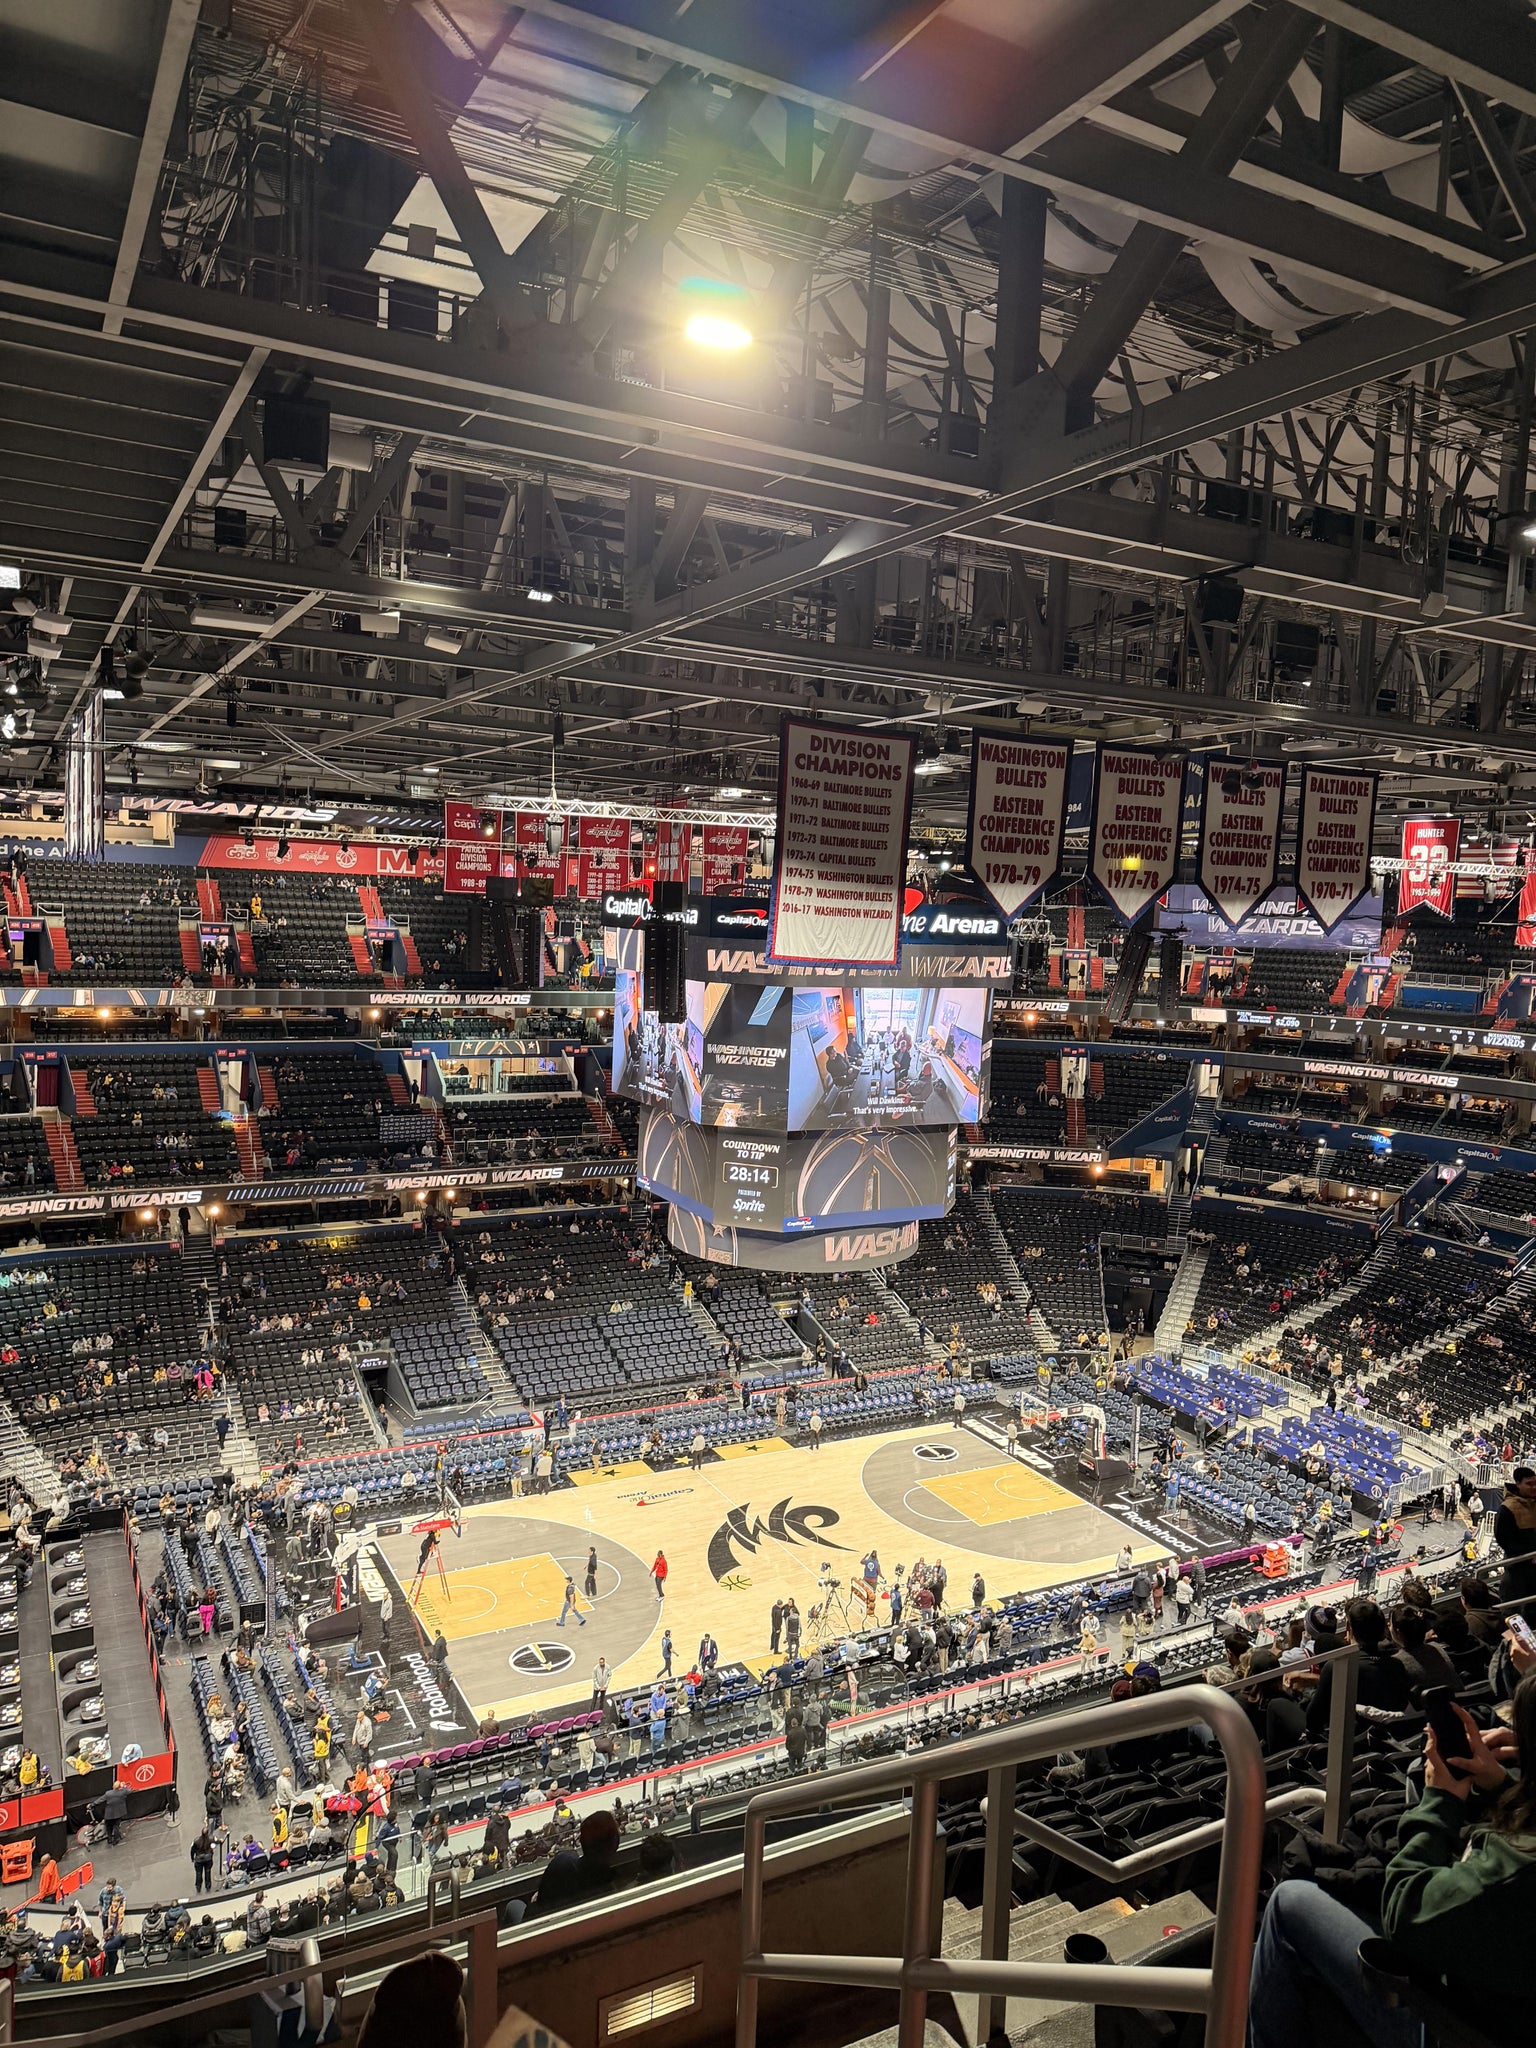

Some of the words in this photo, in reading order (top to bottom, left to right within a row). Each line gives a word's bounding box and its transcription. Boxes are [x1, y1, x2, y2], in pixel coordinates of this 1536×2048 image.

[810, 735, 891, 761] DIVISION
[980, 743, 1065, 769] WASHINGTON
[795, 754, 902, 781] CHAMPIONS
[1104, 756, 1181, 779] WASHINGTON
[996, 767, 1047, 788] BULLETS
[1211, 767, 1280, 788] WATON
[1310, 777, 1369, 797] BALTIMORE
[791, 777, 820, 791] 1968-69
[823, 782, 862, 796] BALTIMORE
[863, 786, 892, 798] BULLETS
[1118, 778, 1165, 797] BULLETS
[122, 796, 338, 821] WIZARDS
[790, 795, 819, 809] 1970-71
[823, 800, 862, 814] BALTIMORE
[863, 805, 891, 816] BULLETS
[993, 796, 1043, 816] EASTERN
[1115, 805, 1162, 823] EASTERN
[1319, 797, 1358, 815] BULLETS
[789, 813, 818, 826] 1971-72
[821, 818, 861, 832] BALTIMORE
[862, 822, 890, 833] BULLETS
[979, 815, 1055, 836] CONFERENCE
[1222, 814, 1263, 831] EASTERN
[1318, 822, 1355, 839] EASTERN
[788, 831, 816, 844] 1972-73
[820, 835, 860, 849] BALTIMORE
[860, 840, 888, 851] BULLETS
[1102, 824, 1172, 843] CONFERENCE
[1209, 832, 1272, 850] CONFERENCE
[1417, 829, 1444, 838] HUNTER
[981, 835, 1049, 855] CHAMPIONS
[1103, 843, 1167, 861] CHAMPIONS
[1307, 839, 1364, 856] CONFERENCE
[456, 862, 491, 872] CHAMPIONS
[786, 849, 815, 862] 1973-74
[819, 853, 847, 865] CAPITAL
[848, 856, 876, 867] BULLETS
[1210, 850, 1267, 868] CHAMPIONS
[1308, 857, 1360, 873] CHAMPIONS
[786, 867, 814, 879] 1974-75
[817, 871, 864, 884] WASHINGTON
[866, 874, 893, 885] BULLETS
[985, 863, 1041, 885] 1978-79
[1108, 870, 1158, 889] 1977-78
[784, 885, 813, 897] 1978-79
[816, 889, 864, 901] WASHINGTON
[865, 892, 893, 903] BULLETS
[1214, 876, 1260, 895] 1974-75
[1311, 881, 1353, 900] 1970-71
[782, 902, 811, 914] 2016-17
[814, 907, 861, 918] WASHINGTON
[863, 909, 893, 920] WIZARDS
[930, 914, 999, 935] Arena
[1208, 916, 1324, 936] WZARDS
[370, 994, 461, 1004] WASHINGTON
[465, 995, 531, 1004] WIZARDS
[1011, 1000, 1070, 1012] WIZARDS
[707, 1044, 786, 1058] WASHINGTON
[1483, 1035, 1526, 1048] WIZARDS
[715, 1055, 777, 1067] WIZARDS
[1304, 1061, 1389, 1079] WASHINGTON
[1393, 1070, 1459, 1087] WIZARDS
[723, 1140, 780, 1153] COUNTDOWN
[737, 1150, 749, 1158] TO
[751, 1151, 765, 1160] TIP
[969, 1148, 1050, 1160] WASHINGTON
[386, 1172, 487, 1191] WASHINGTON
[492, 1168, 564, 1183] WIZARDS
[729, 1166, 770, 1184] 28:14
[111, 1191, 202, 1209] WIZARDS
[733, 1198, 765, 1212] Sprite
[1121, 1511, 1198, 1553] Robinhood
[400, 1652, 452, 1718] Robinhood
